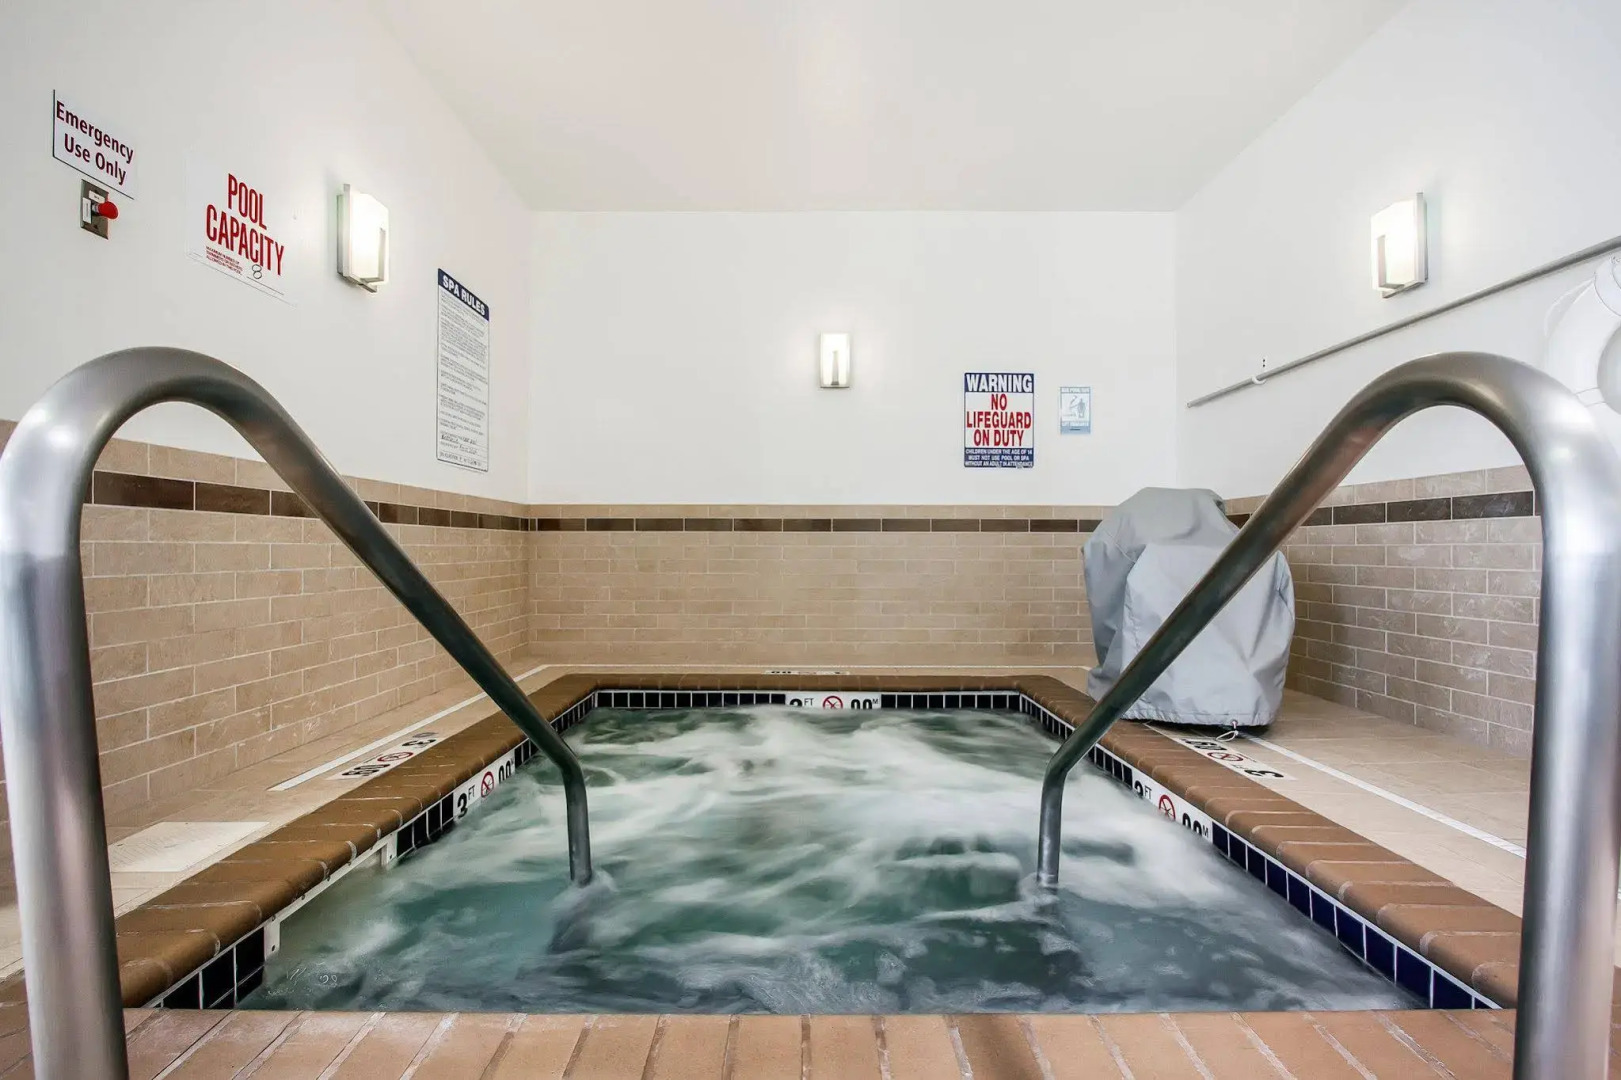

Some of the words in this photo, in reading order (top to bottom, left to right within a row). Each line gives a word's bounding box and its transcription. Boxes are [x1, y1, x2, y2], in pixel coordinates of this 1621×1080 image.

[56, 100, 134, 164] Emergency
[64, 133, 91, 163] Use
[95, 152, 126, 186] Only
[228, 173, 268, 230] POOL
[206, 204, 285, 276] CAPACITY
[252, 264, 262, 279] 8
[443, 275, 460, 297] SPA
[461, 288, 486, 316] RULES
[966, 374, 1032, 392] WARNING
[991, 394, 1007, 410] NO
[967, 412, 1031, 429] LIFEGUARD
[974, 429, 989, 446] ON
[994, 430, 1024, 446] DUTY
[457, 792, 469, 819] 3
